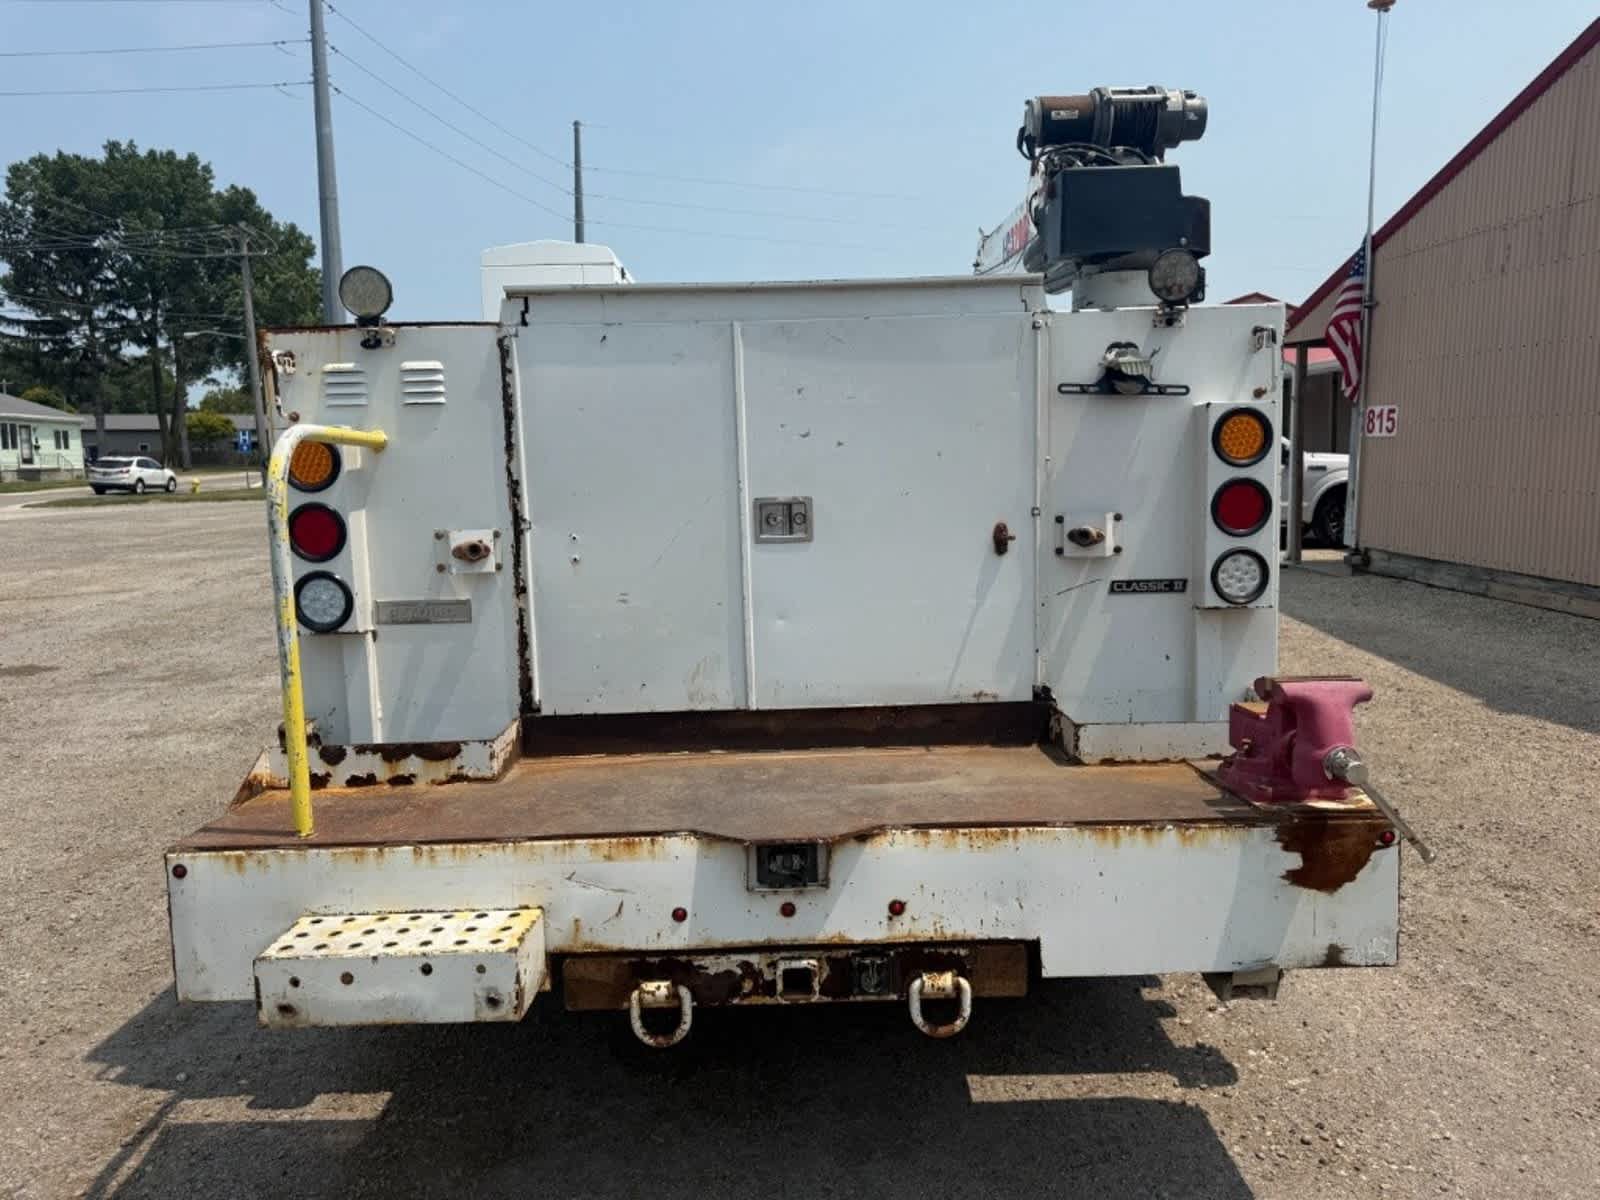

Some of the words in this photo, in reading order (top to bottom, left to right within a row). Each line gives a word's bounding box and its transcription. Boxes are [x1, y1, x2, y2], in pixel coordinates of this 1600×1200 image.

[1367, 408, 1396, 434] 815
[240, 430, 249, 445] H
[1113, 581, 1169, 592] CLASSIC
[1174, 580, 1183, 591] II
